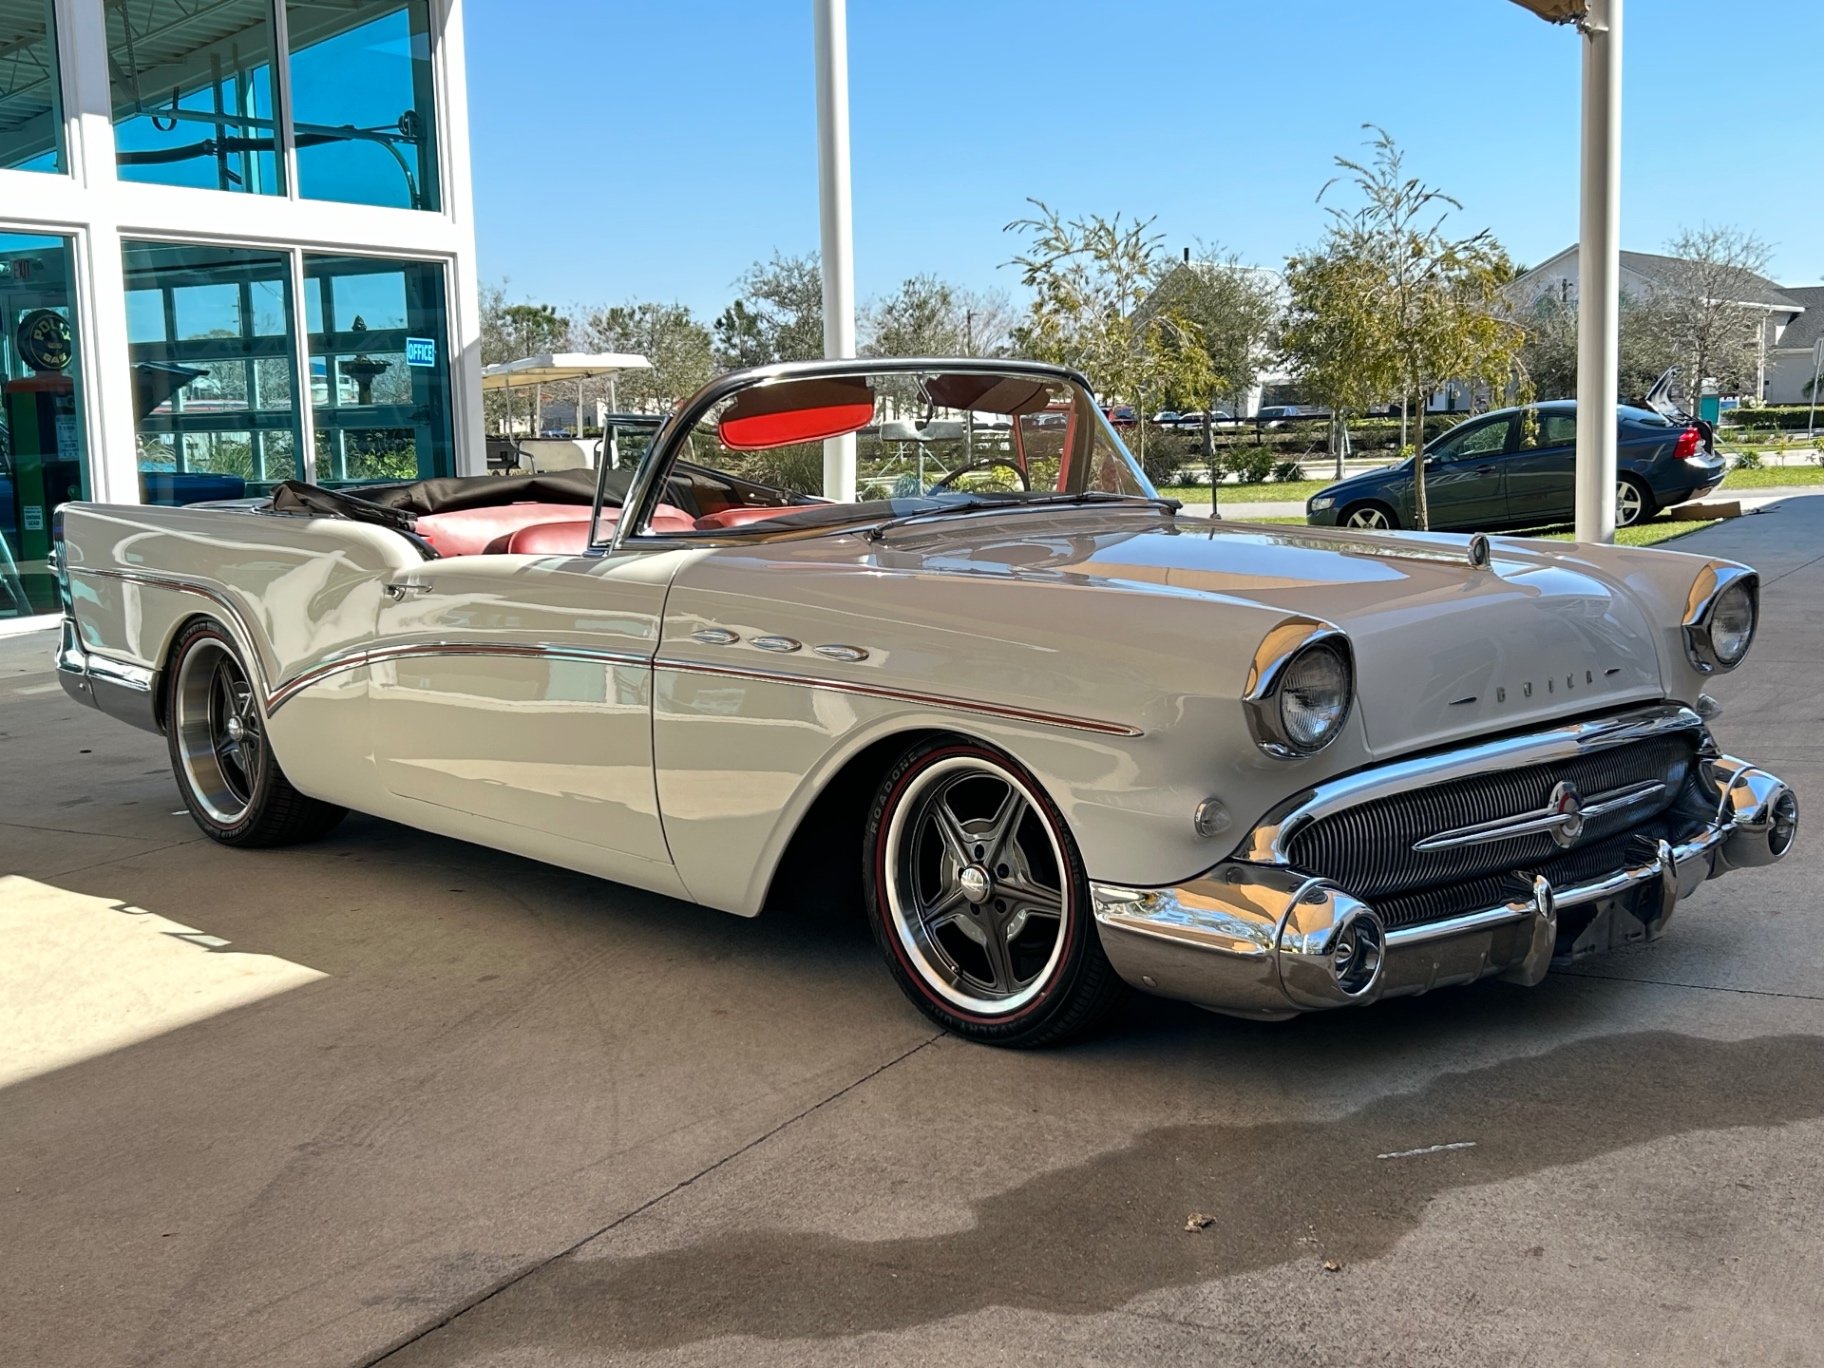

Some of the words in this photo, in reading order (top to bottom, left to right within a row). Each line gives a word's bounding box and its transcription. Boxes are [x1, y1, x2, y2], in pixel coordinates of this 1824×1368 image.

[14, 260, 31, 280] EXIT
[42, 352, 67, 364] GAS
[408, 343, 433, 361] OFFICE
[869, 751, 917, 834] ROADONE
